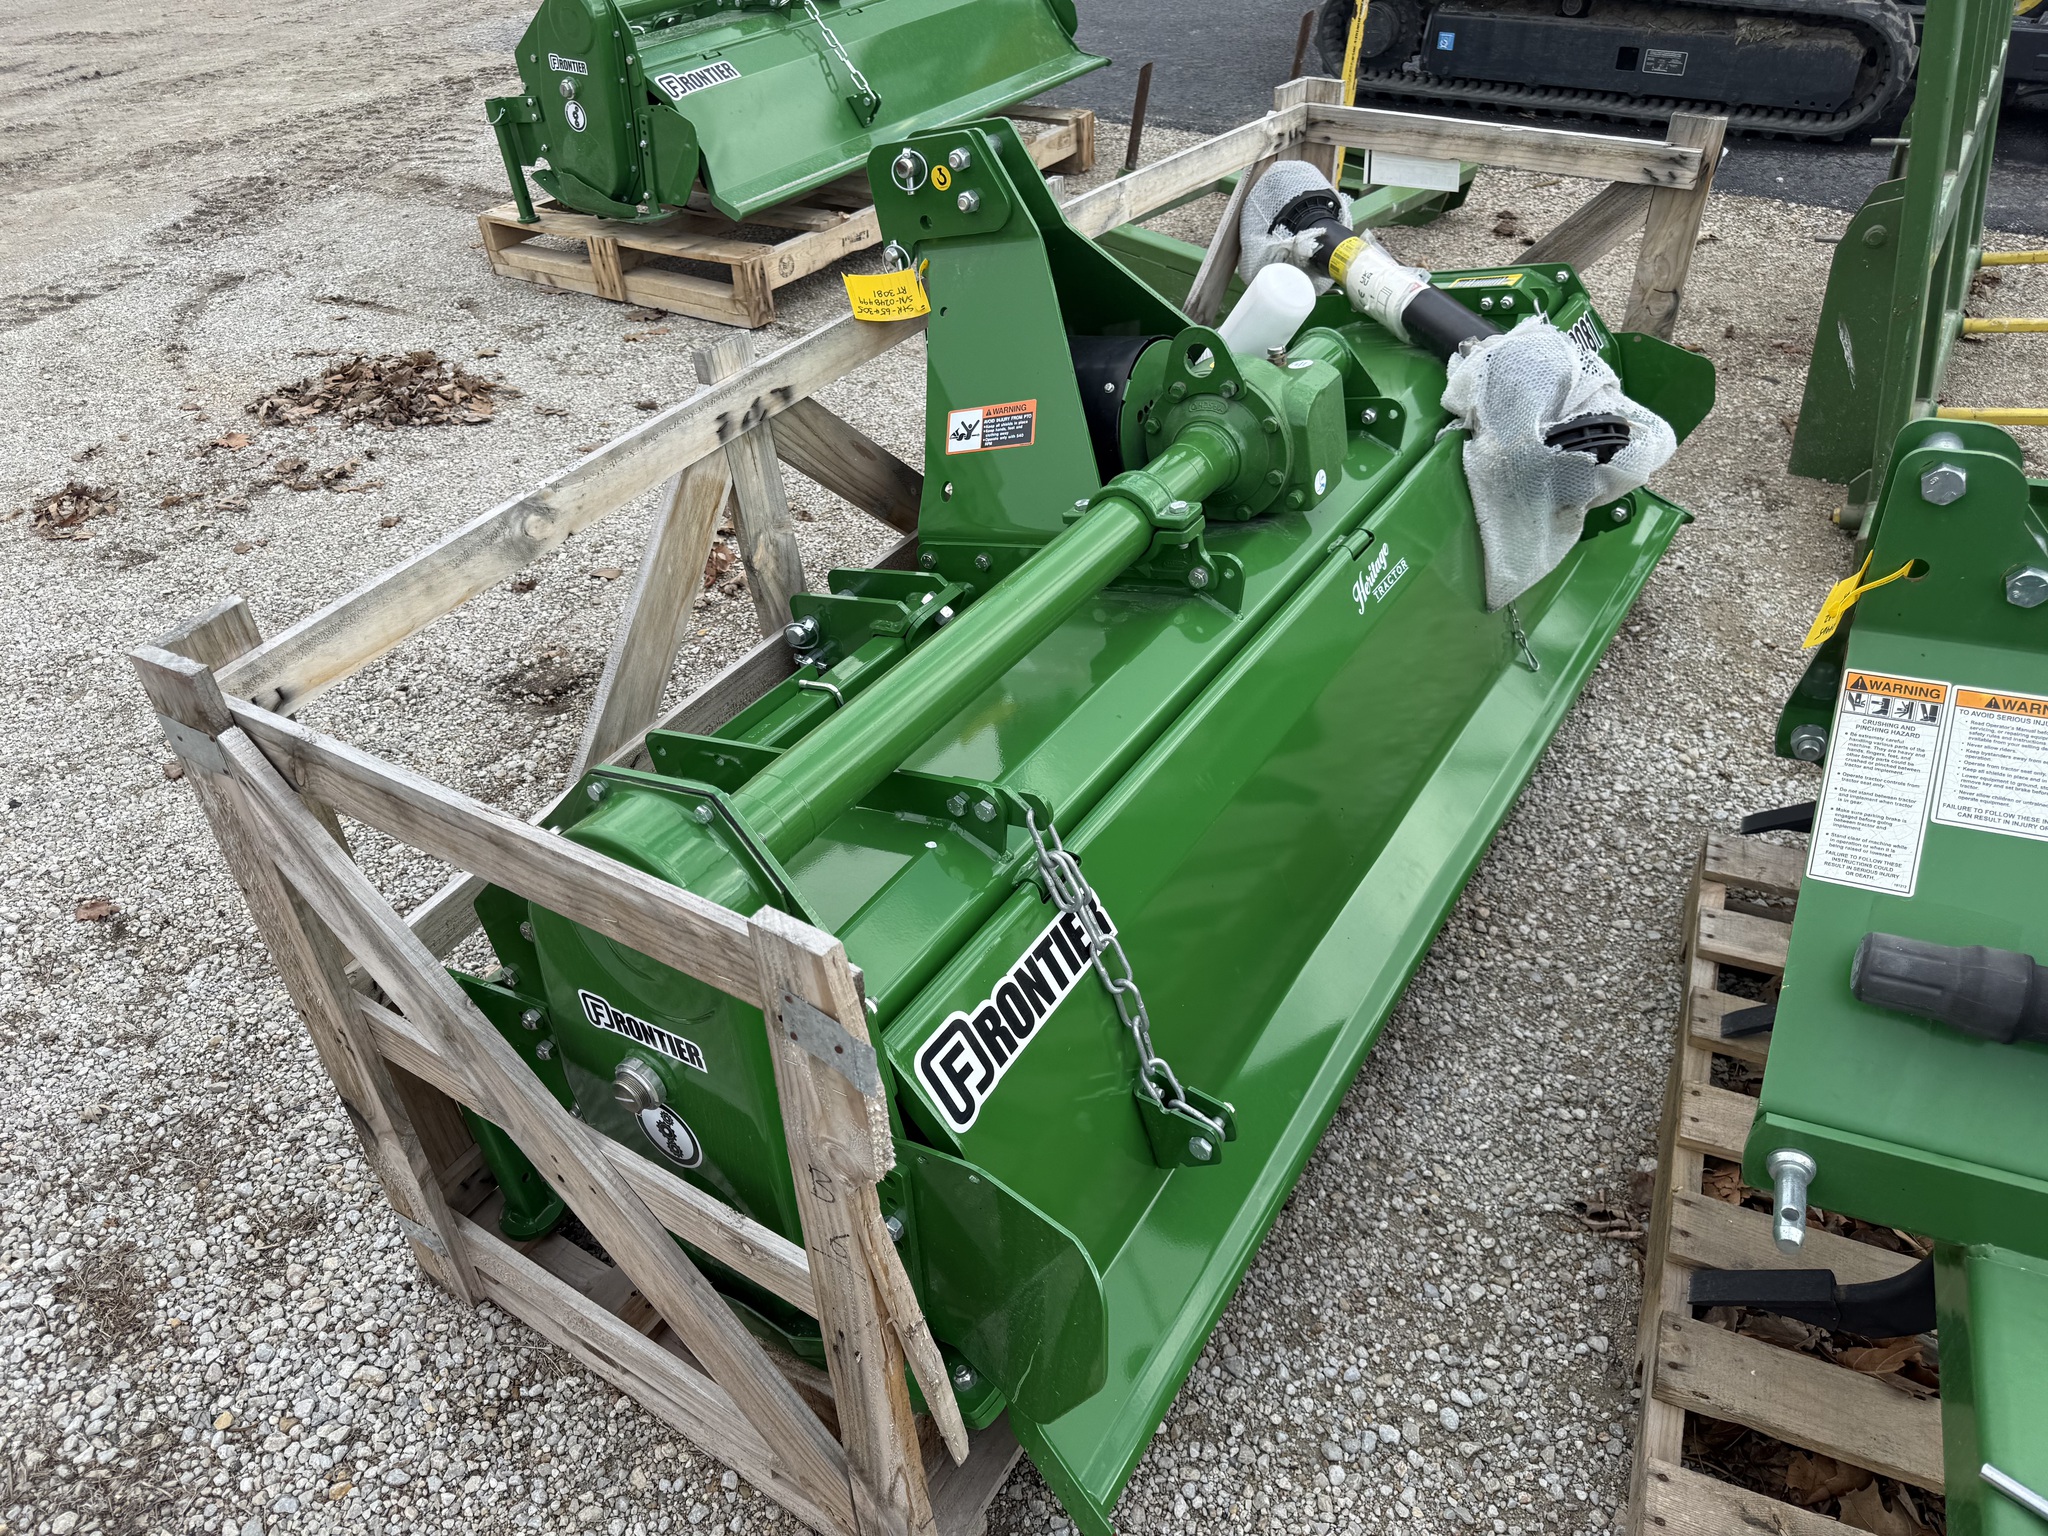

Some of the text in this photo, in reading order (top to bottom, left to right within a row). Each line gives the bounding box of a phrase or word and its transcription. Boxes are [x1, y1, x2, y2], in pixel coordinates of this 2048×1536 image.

[549, 54, 587, 74] FRONTIER
[657, 62, 738, 98] FRONTIER
[992, 404, 1027, 415] WARNING
[1352, 542, 1389, 615] Heritage
[1373, 559, 1409, 600] TRACTOR
[1869, 680, 1940, 699] WARNING
[1862, 718, 1899, 728] CRUSHING
[1970, 710, 1994, 718] AVOID
[1996, 714, 2031, 724] SERIOUS
[1855, 724, 1920, 738] PINCHING HAZARD
[1942, 802, 1972, 812] FAILURE
[1984, 809, 2015, 819] FOLLOW
[2016, 814, 2040, 823] THESE
[1973, 814, 2001, 823] RESULT
[2011, 820, 2037, 829] INJURY
[1831, 856, 1893, 872] INSTRUCTIONS COULD
[1858, 856, 1882, 864] FOLLOW
[1852, 866, 1878, 875] SERIOUS
[1854, 872, 1875, 880] DEATH.
[581, 992, 704, 1069] FRONTIER
